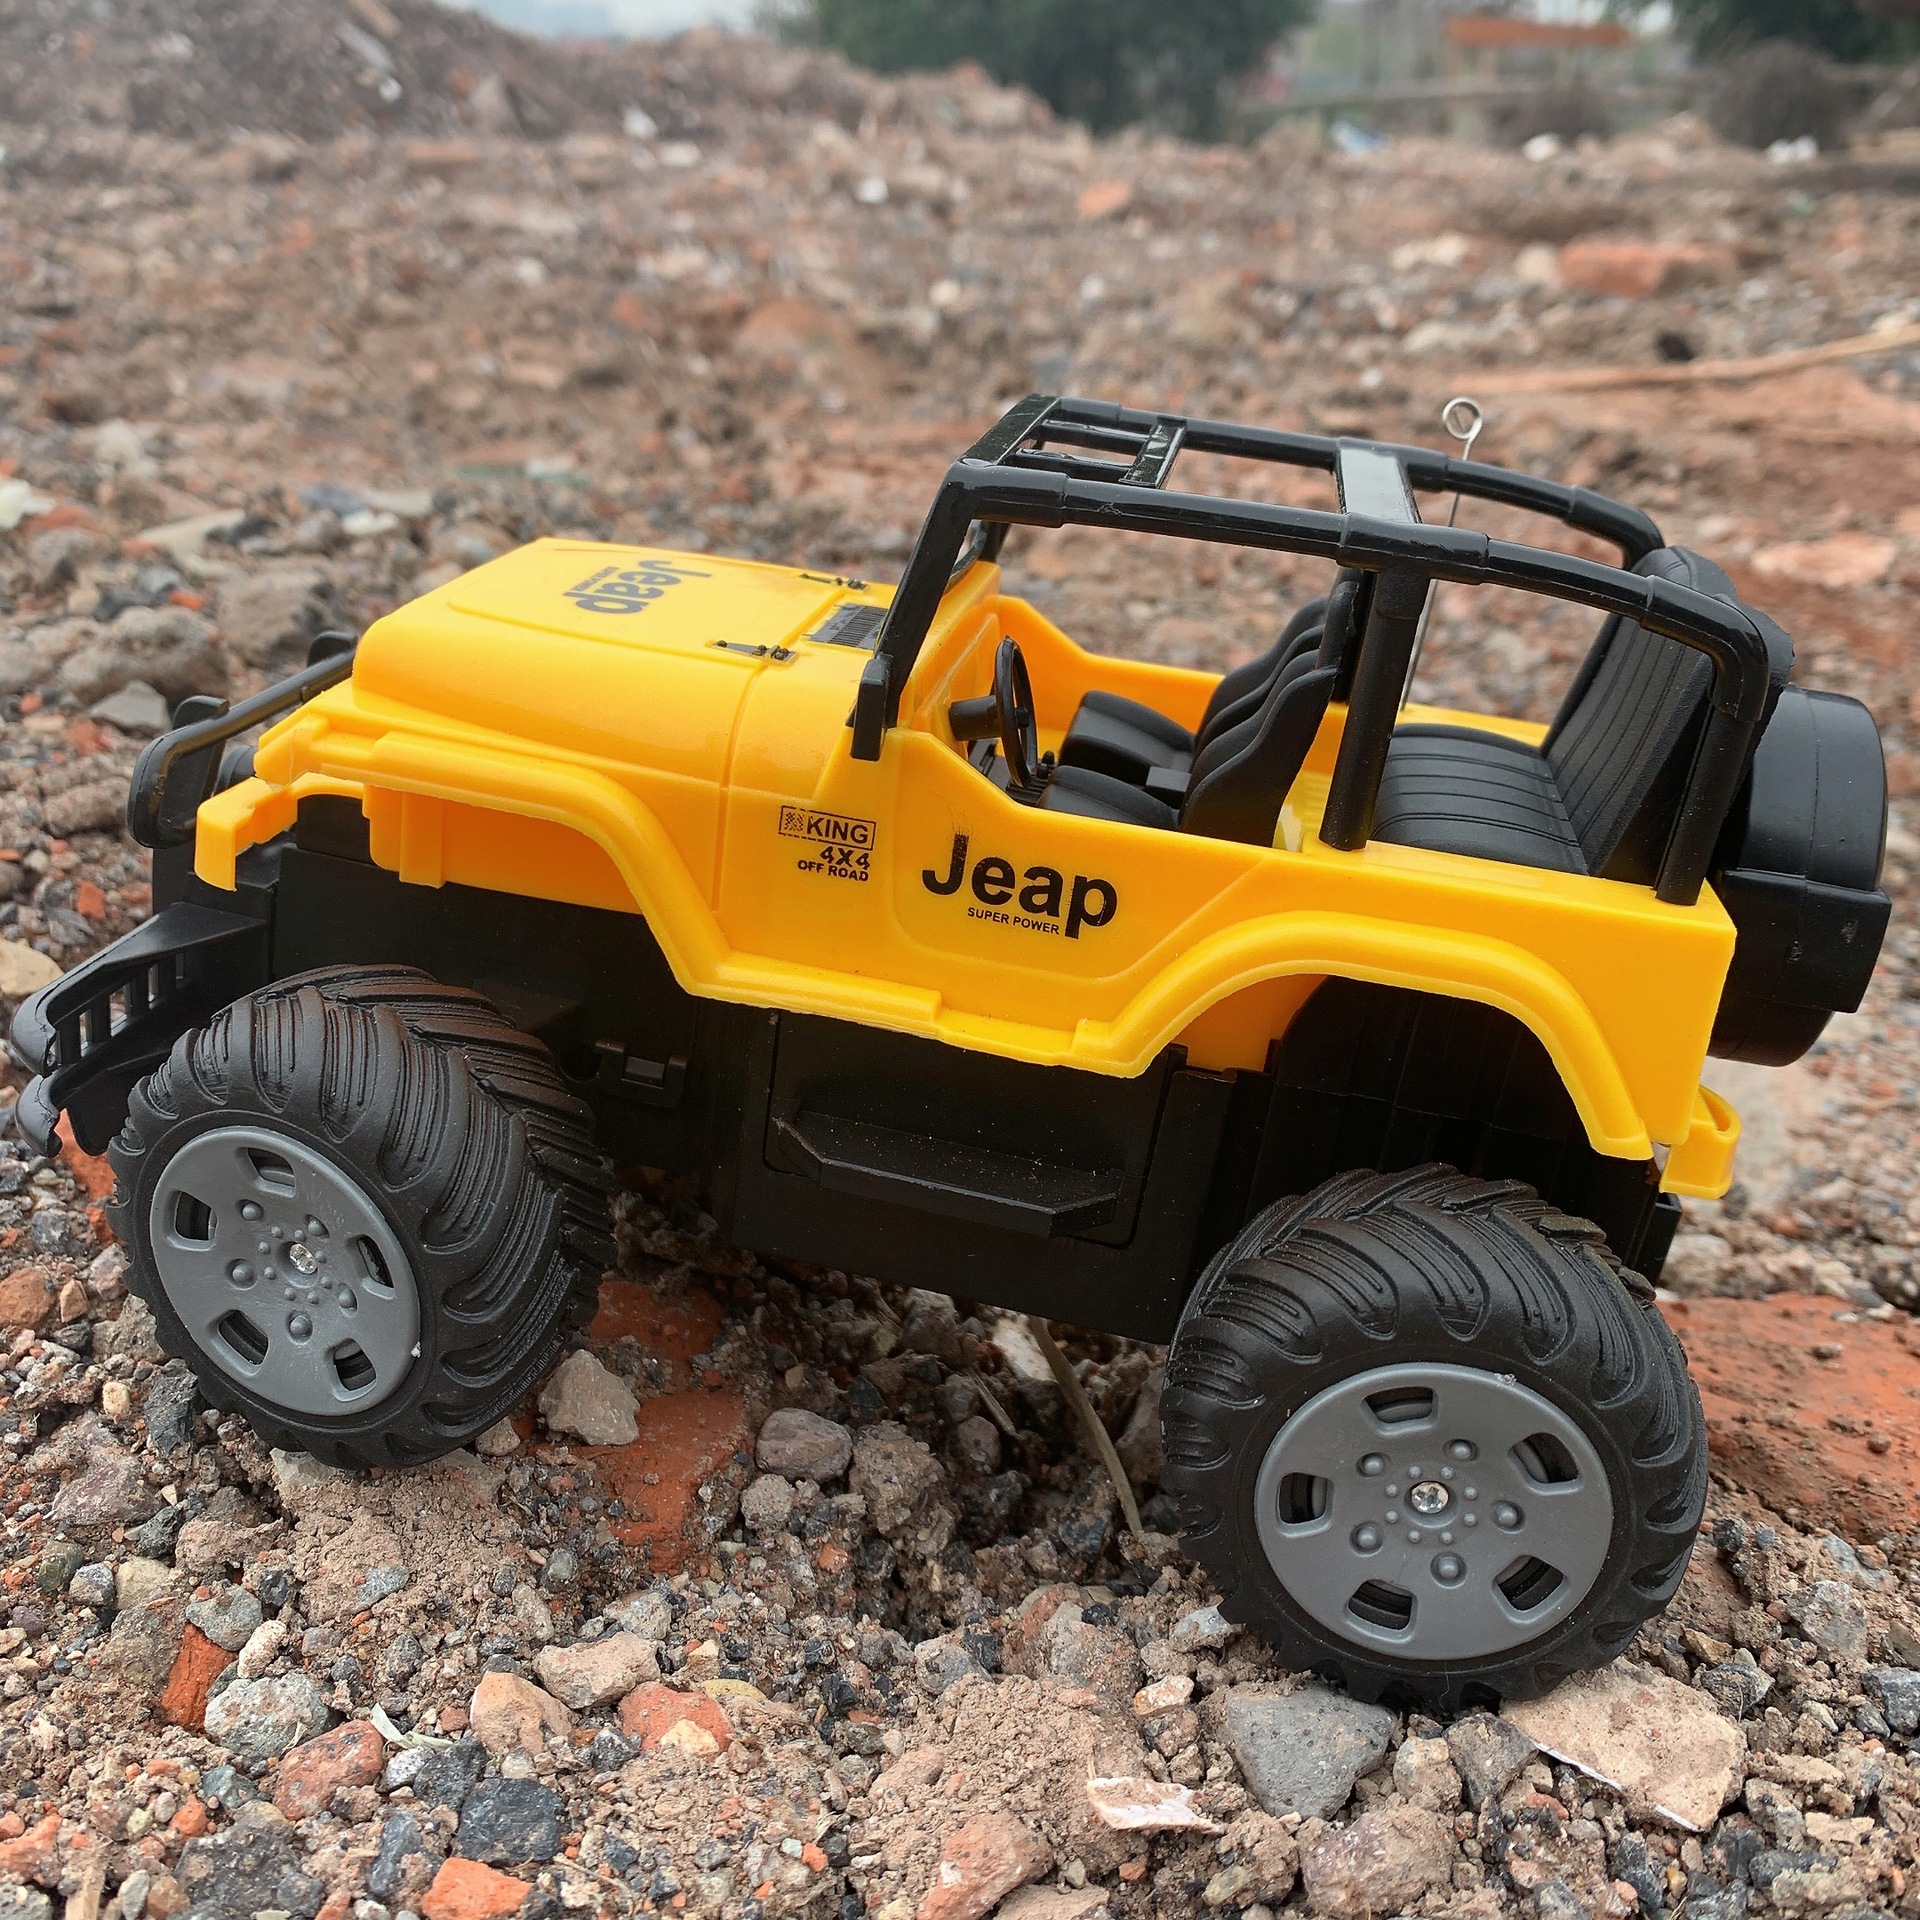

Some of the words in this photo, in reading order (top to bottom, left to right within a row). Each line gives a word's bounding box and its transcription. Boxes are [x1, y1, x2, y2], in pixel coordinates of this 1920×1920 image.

[562, 559, 712, 614] Jeap
[806, 815, 868, 844] KING
[797, 859, 824, 873] OFF
[827, 865, 868, 882] ROAD
[819, 845, 870, 870] 4X4
[922, 832, 1118, 940] Jeap
[967, 907, 1009, 925] SUPER
[1012, 916, 1060, 936] POWER
